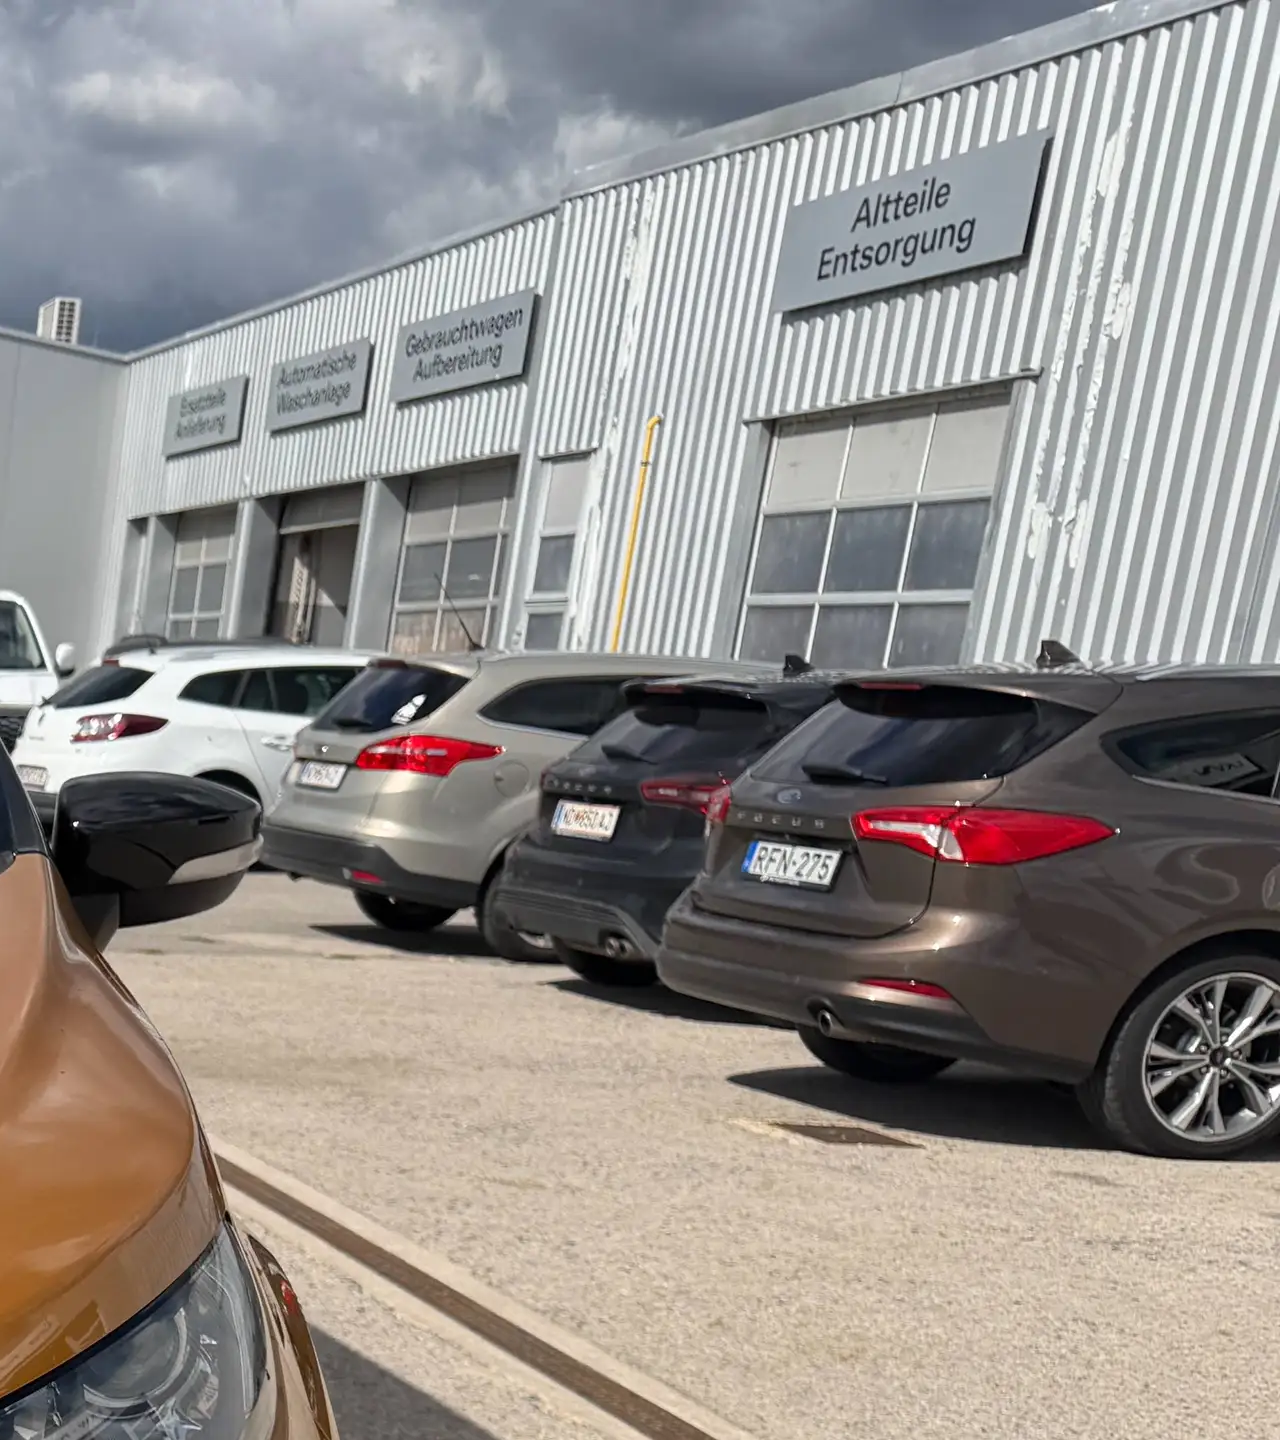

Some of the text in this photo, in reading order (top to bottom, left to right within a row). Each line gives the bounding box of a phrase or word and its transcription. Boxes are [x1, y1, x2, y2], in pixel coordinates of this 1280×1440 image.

[851, 176, 951, 233] Altteile
[816, 217, 976, 281] Entsorgung
[405, 308, 523, 358] Gebrauchtwagen
[412, 343, 503, 383] Aufbereitung
[753, 846, 833, 880] RFN-275
